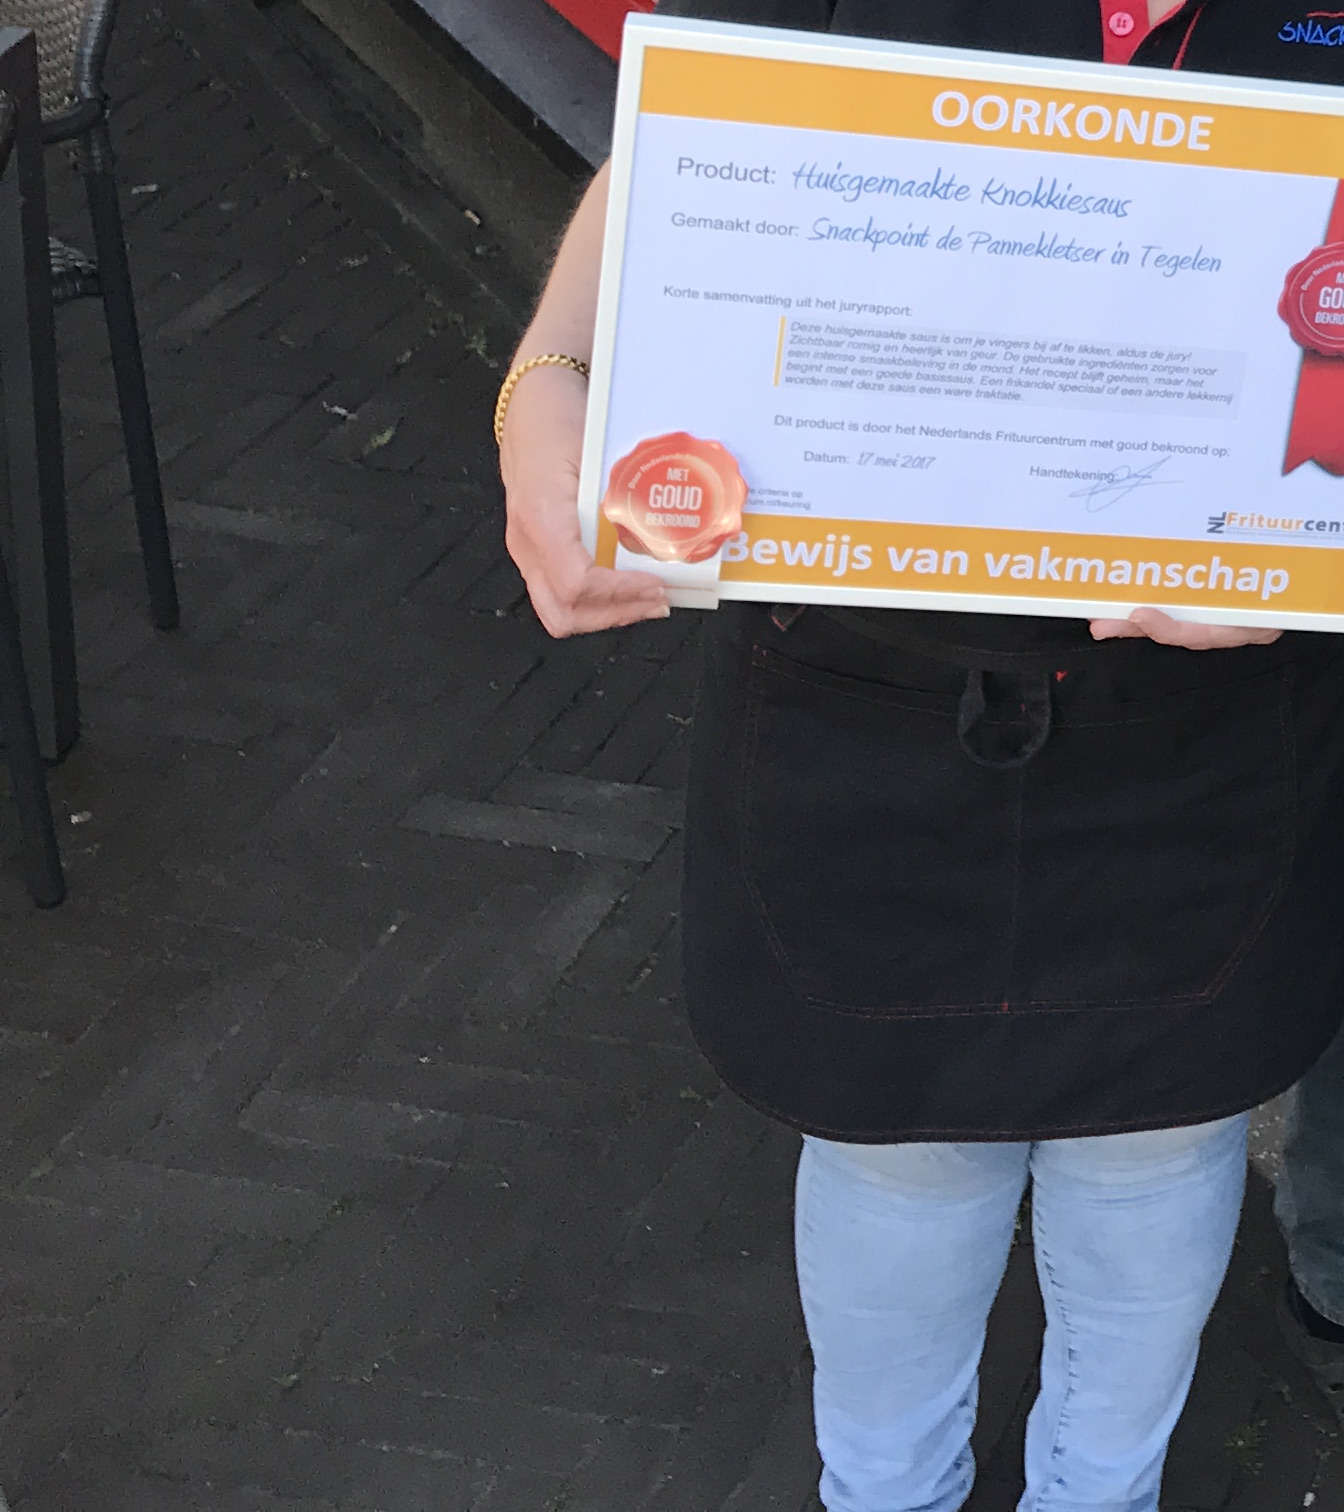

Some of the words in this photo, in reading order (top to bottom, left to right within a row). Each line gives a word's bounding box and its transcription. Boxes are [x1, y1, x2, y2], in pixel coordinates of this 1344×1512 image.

[931, 89, 1214, 151] OORKONDE
[676, 156, 776, 184] Product:
[791, 160, 970, 202] Huisgemaakte
[980, 175, 1132, 218] Knokkiesaus
[670, 211, 751, 233] Gemaakt
[754, 219, 799, 236] door:
[806, 215, 930, 253] Snackpoint
[934, 224, 963, 251] de
[966, 230, 1106, 263] Pannekletser
[1109, 240, 1130, 265] in
[1140, 244, 1222, 278] Tegelen
[666, 467, 690, 481] MET
[802, 450, 850, 464] Datum:
[857, 452, 875, 466] 17
[874, 453, 900, 467] mei
[900, 455, 936, 469] 2017
[649, 484, 703, 511] GOUD
[720, 531, 873, 578] Bewijs
[886, 546, 969, 575] van
[983, 545, 1289, 600] vakmanschap
